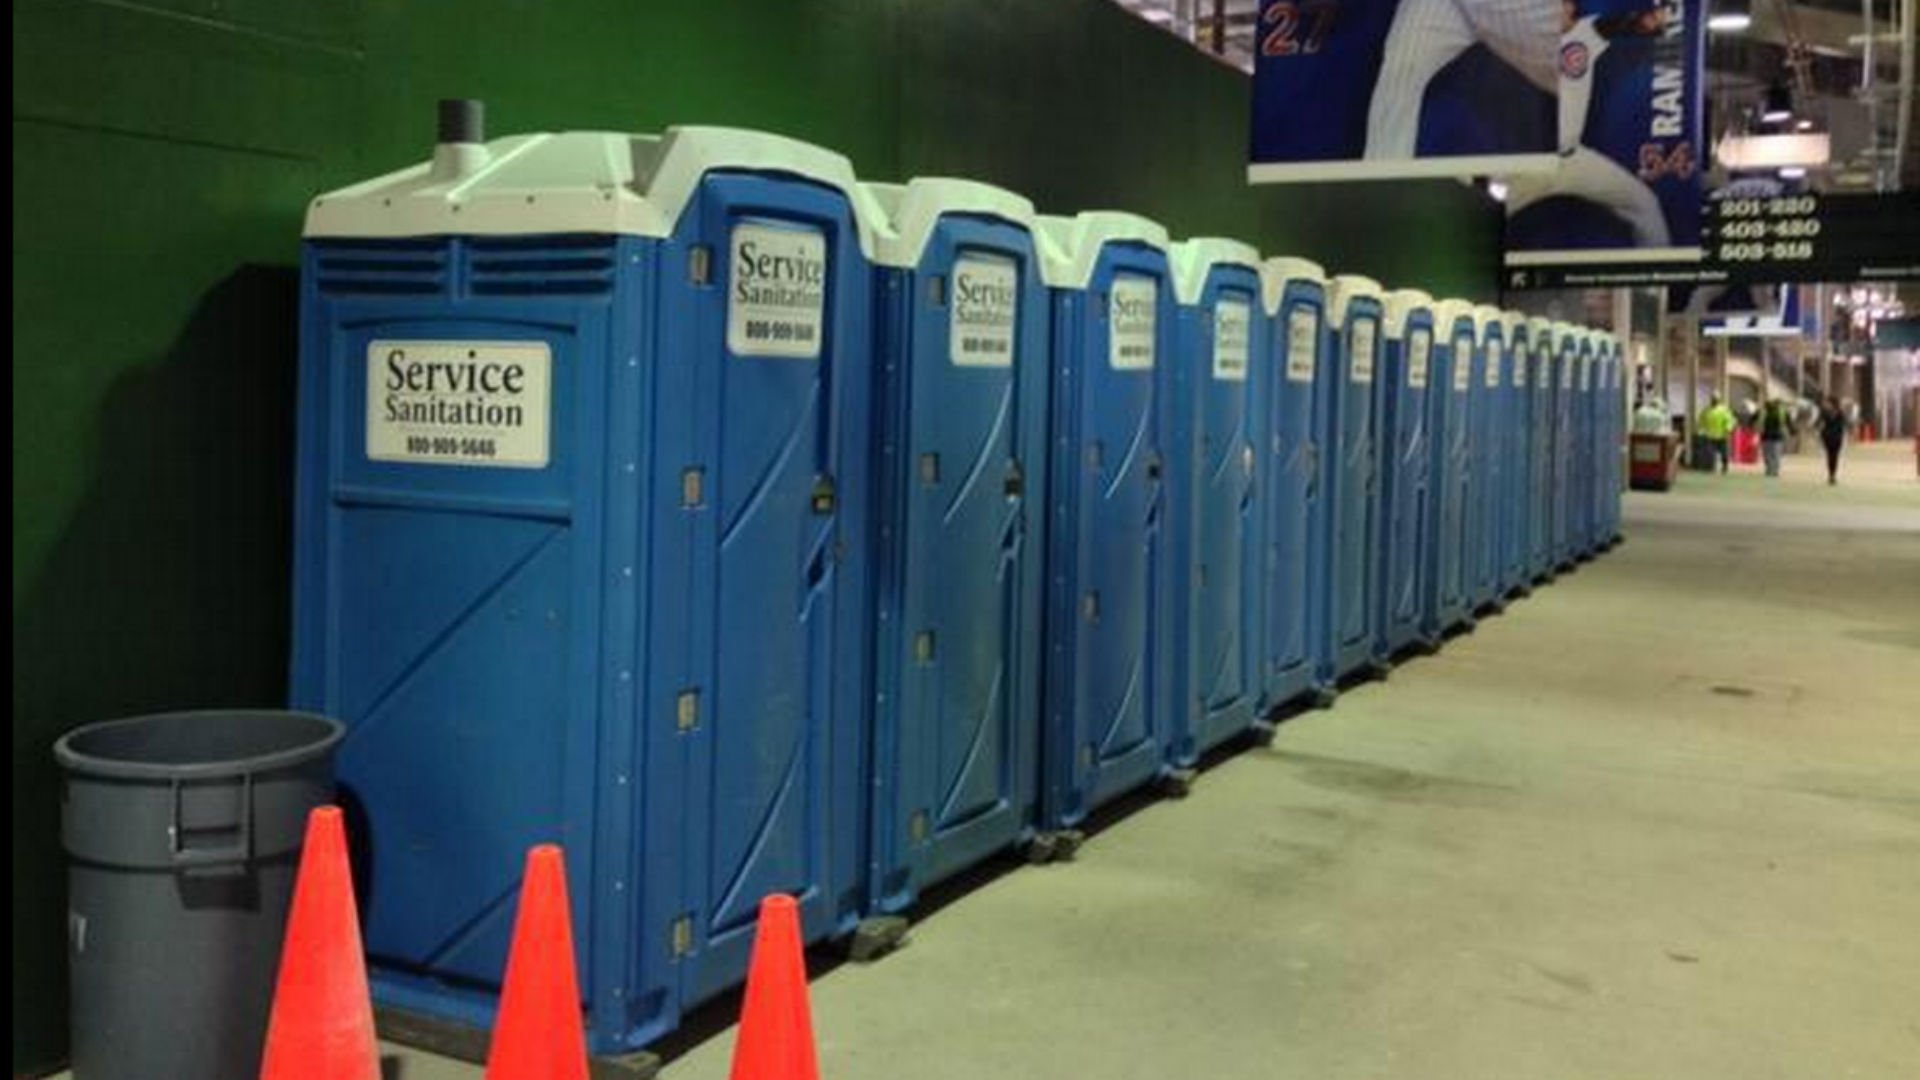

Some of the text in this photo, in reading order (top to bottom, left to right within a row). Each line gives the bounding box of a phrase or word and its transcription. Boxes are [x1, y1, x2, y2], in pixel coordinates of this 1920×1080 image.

[1638, 142, 1695, 181] 54
[738, 241, 821, 284] Service
[386, 349, 524, 394] Service
[385, 394, 523, 427] Sanitation
